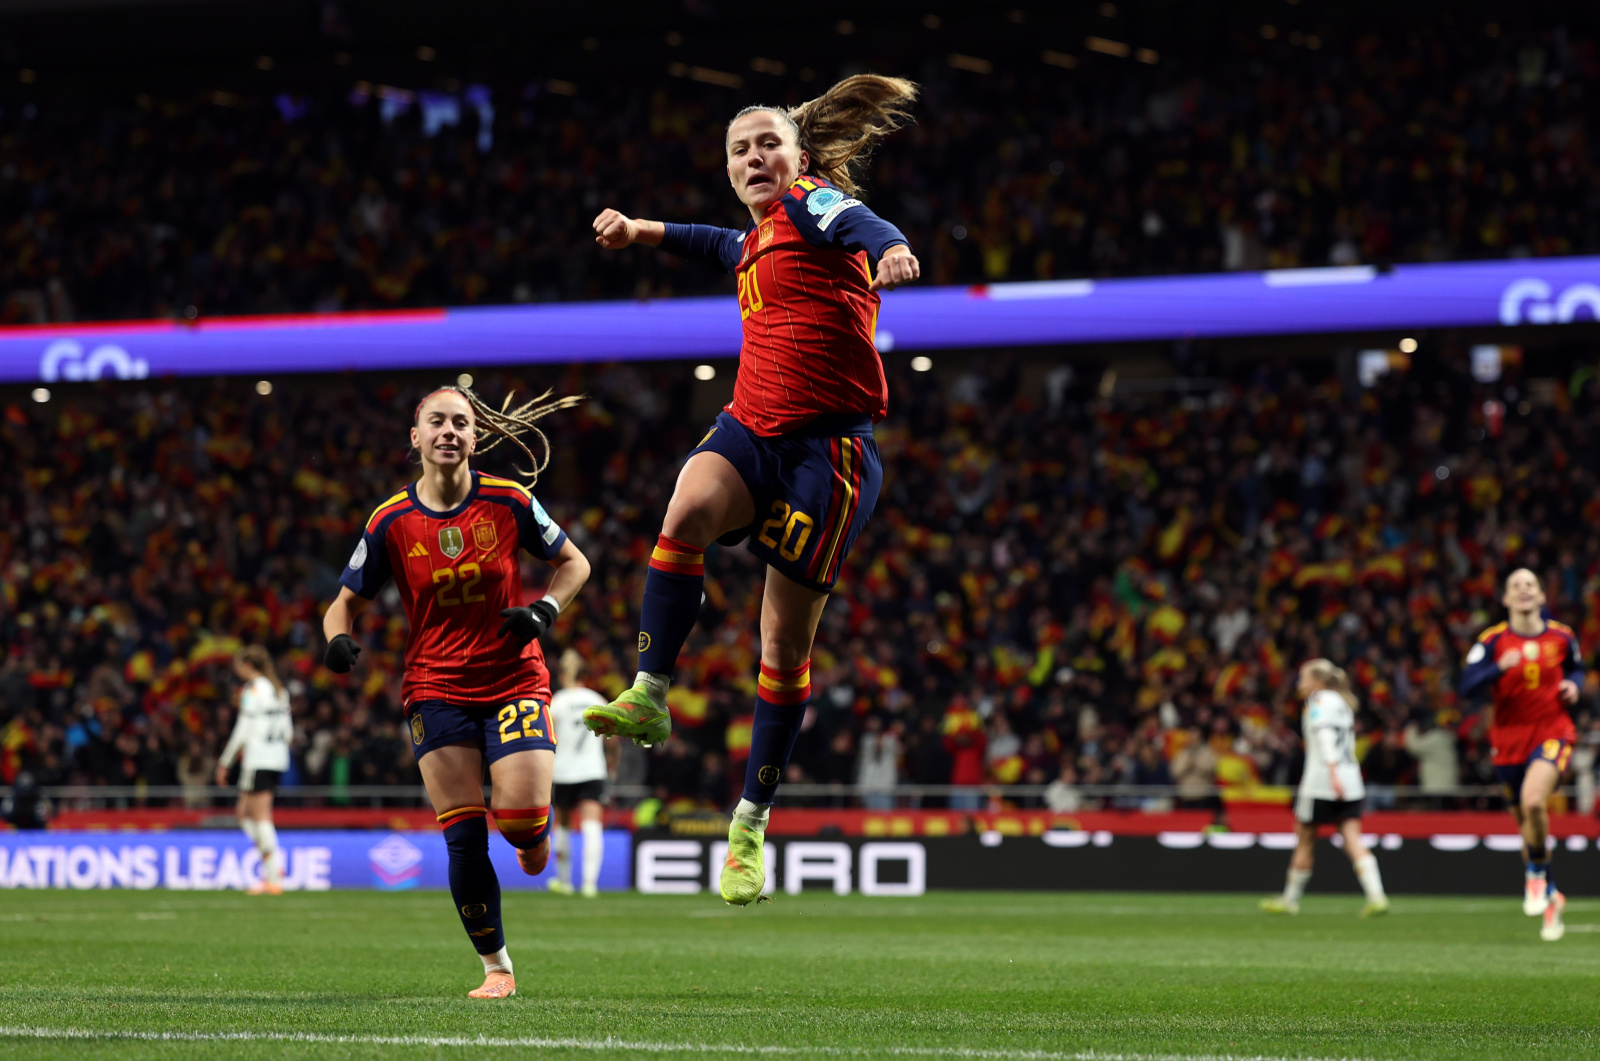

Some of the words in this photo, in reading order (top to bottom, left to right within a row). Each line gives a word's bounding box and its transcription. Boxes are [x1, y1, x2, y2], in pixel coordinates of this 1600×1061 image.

[738, 262, 763, 322] 20
[757, 499, 814, 562] 20
[432, 562, 486, 607] 22
[1523, 661, 1541, 690] 9
[497, 699, 544, 744] 22
[0, 844, 159, 890] ATIONS
